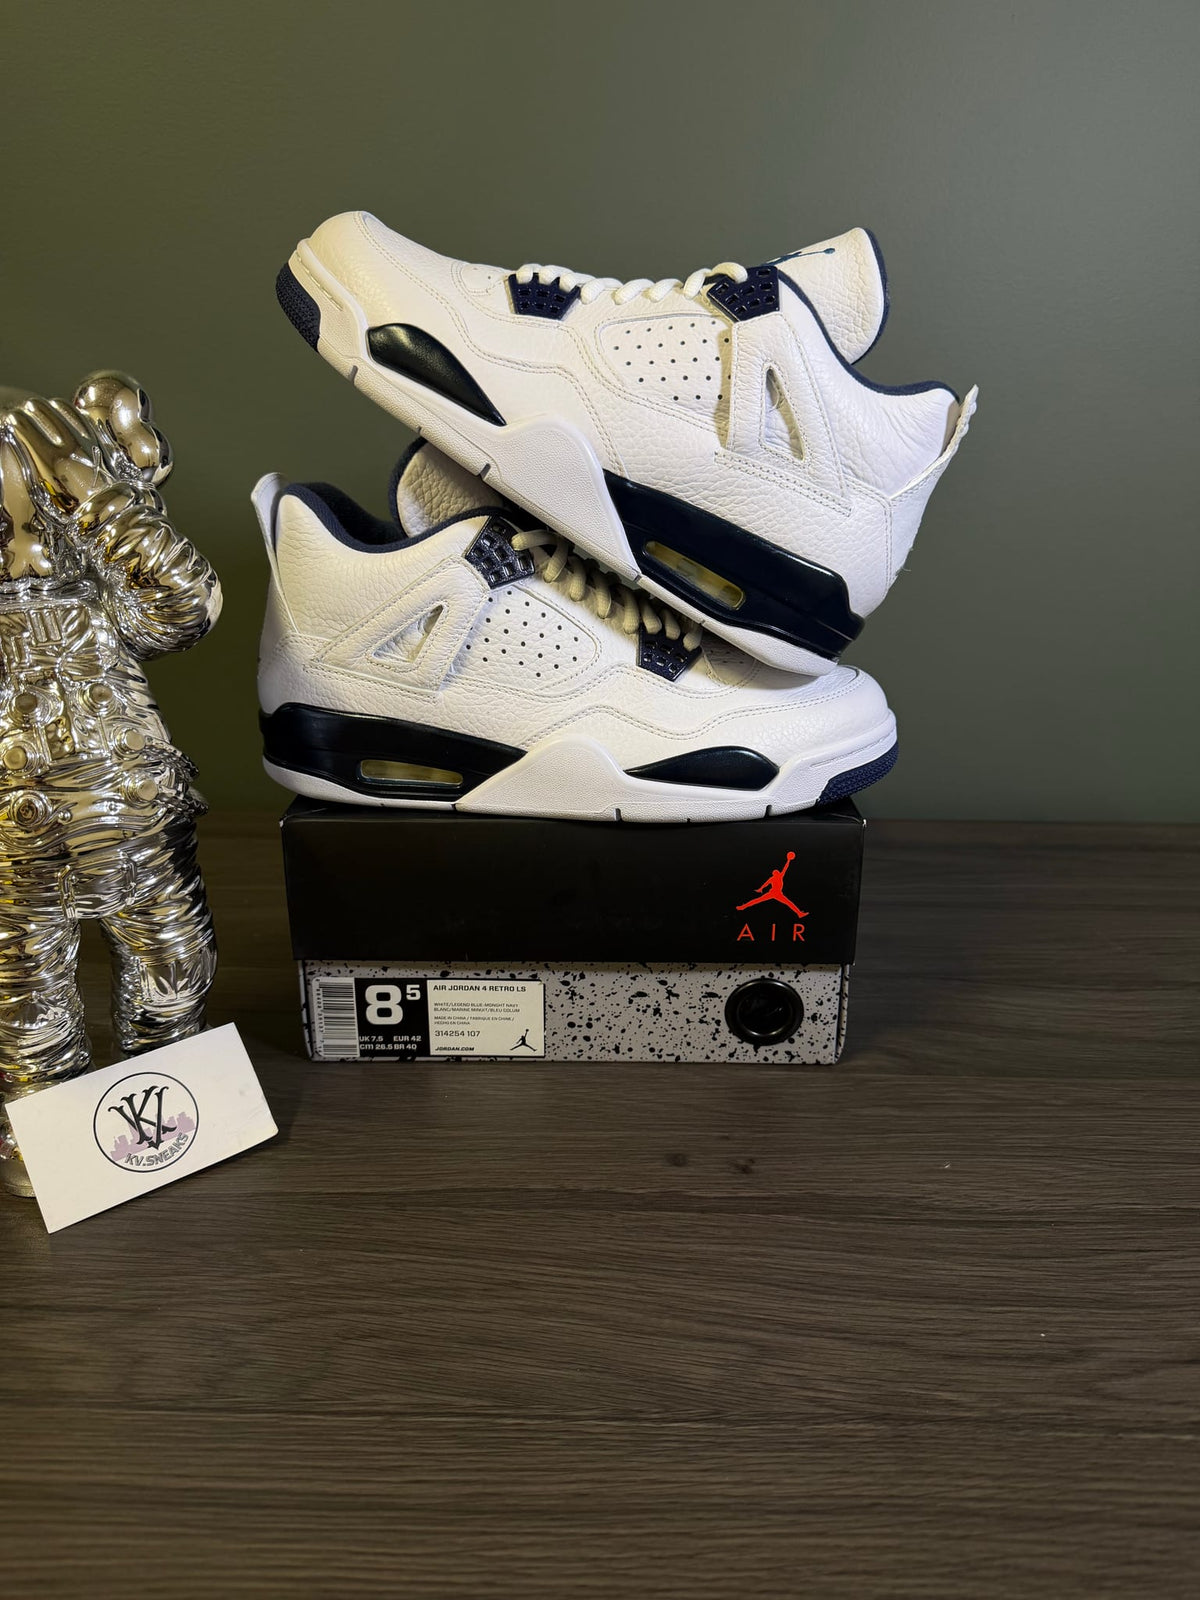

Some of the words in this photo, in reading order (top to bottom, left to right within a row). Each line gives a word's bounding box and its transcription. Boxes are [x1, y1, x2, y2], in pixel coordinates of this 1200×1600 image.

[736, 923, 806, 942] AIR
[364, 984, 404, 1025] 8
[406, 984, 421, 1000] 5
[124, 1132, 189, 1167] KV.SNEAKS
